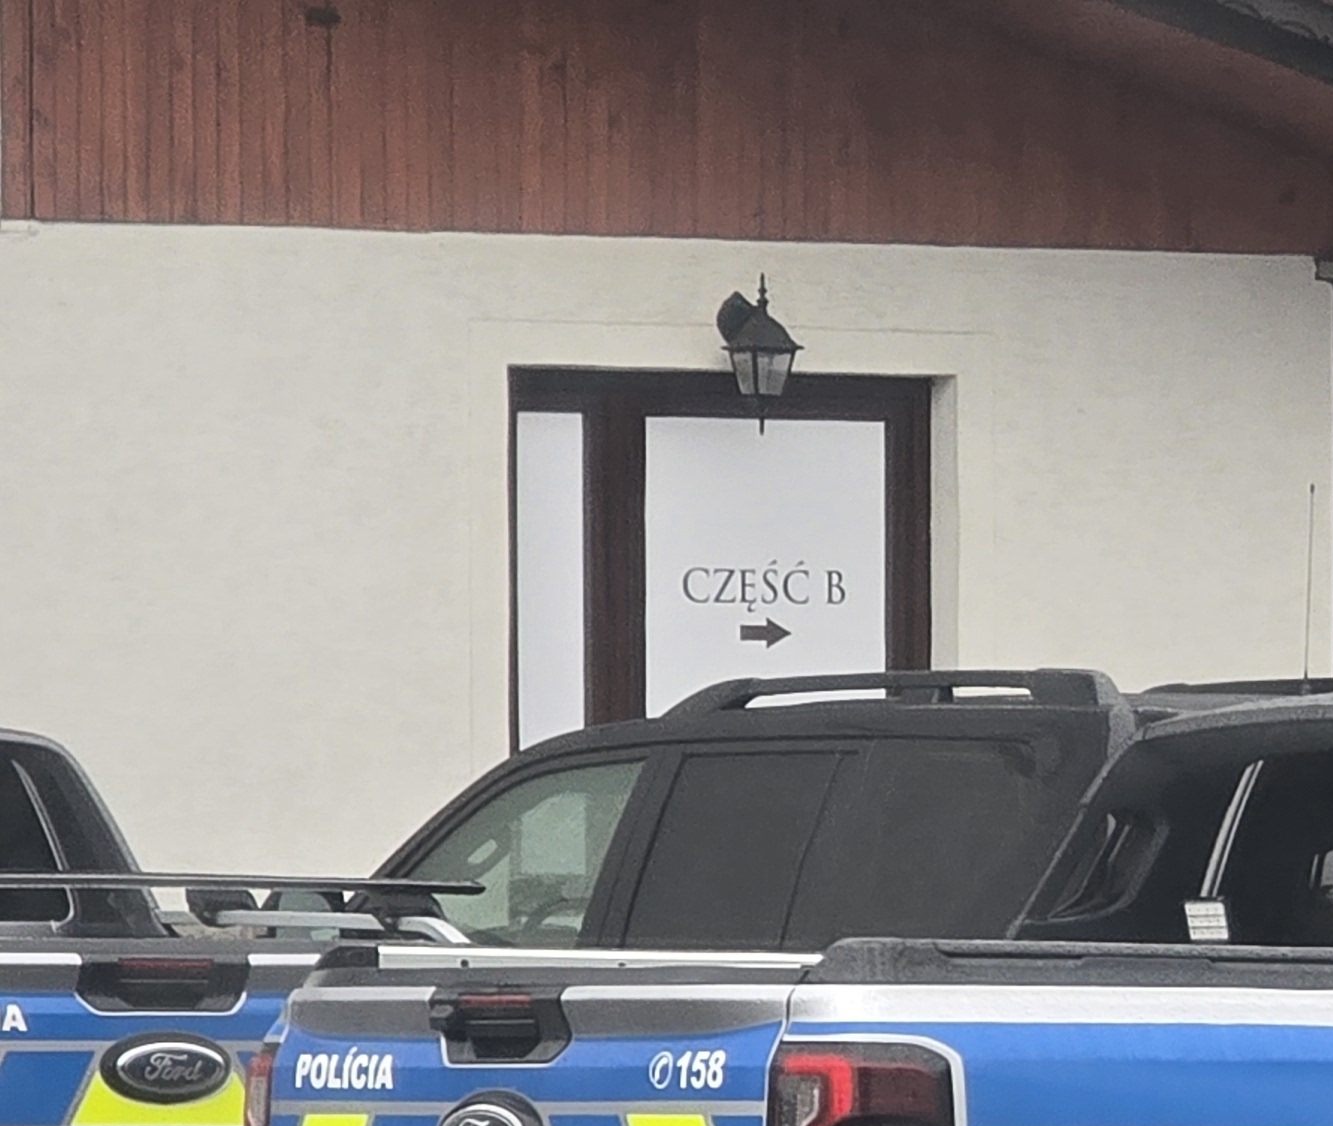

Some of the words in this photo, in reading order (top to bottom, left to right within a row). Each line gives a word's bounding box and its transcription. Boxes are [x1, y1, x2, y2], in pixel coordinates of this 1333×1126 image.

[683, 559, 810, 613] CZĘŚĆ
[826, 570, 847, 605] B
[144, 1052, 202, 1081] Ford
[295, 1047, 394, 1090] POLÍCIA
[677, 1050, 727, 1090] 158
